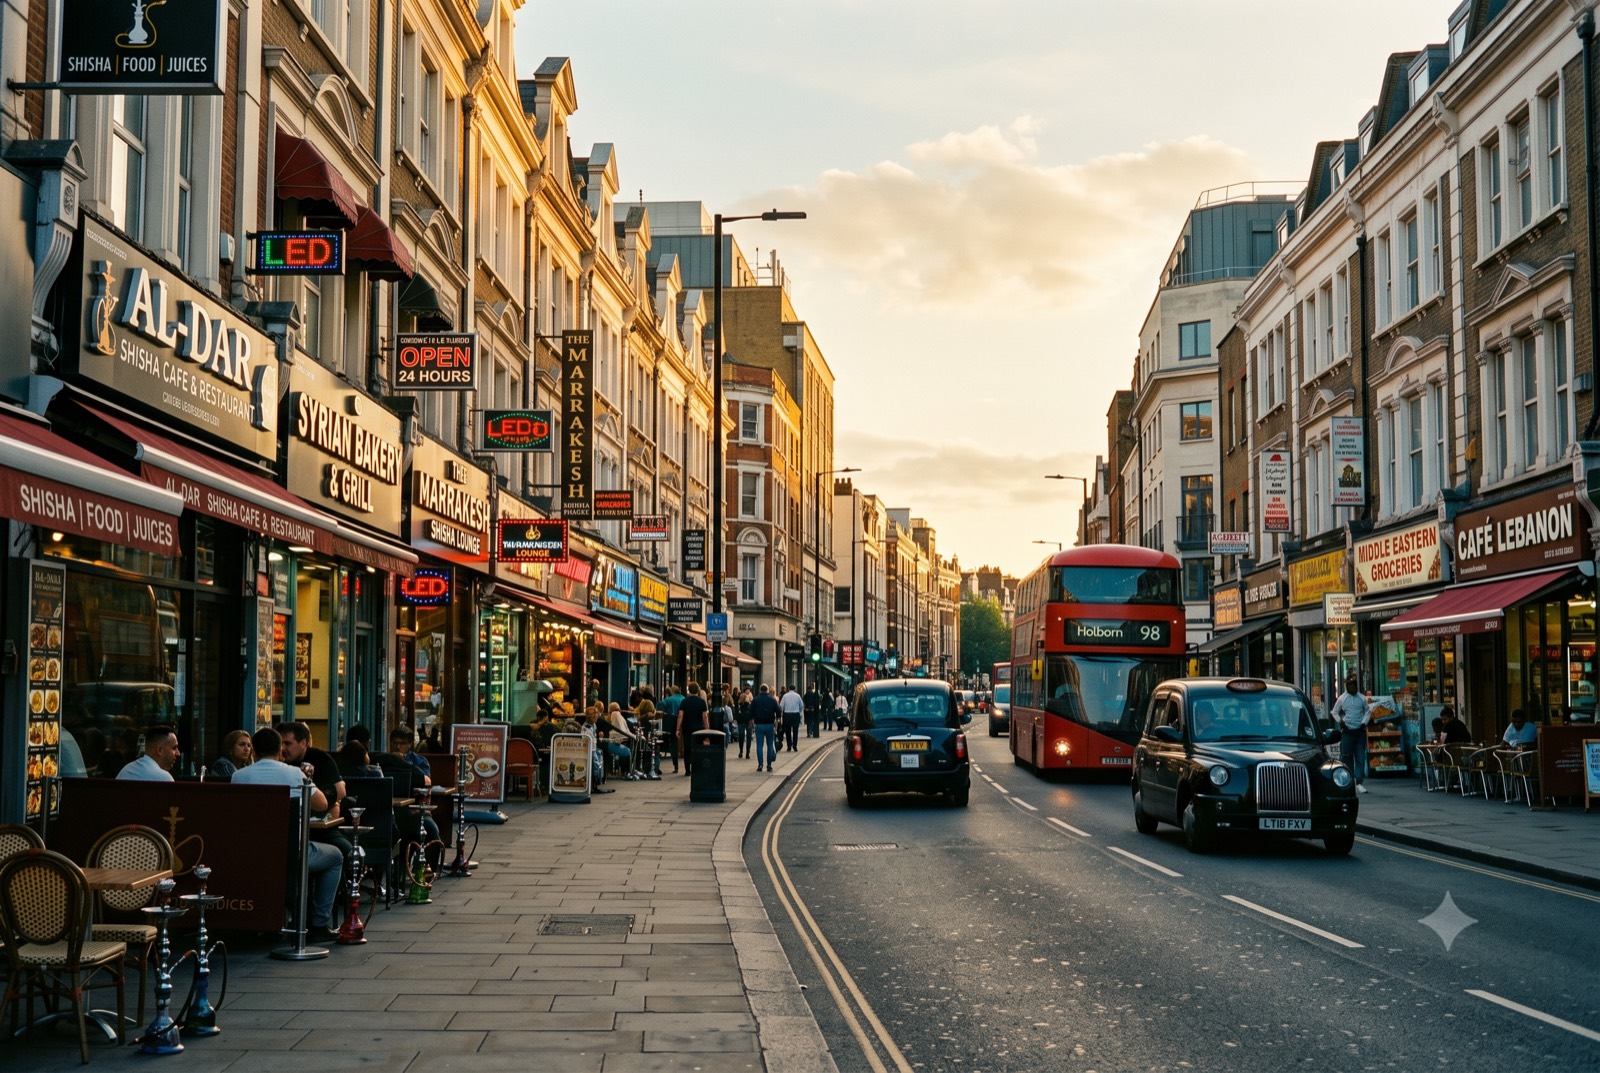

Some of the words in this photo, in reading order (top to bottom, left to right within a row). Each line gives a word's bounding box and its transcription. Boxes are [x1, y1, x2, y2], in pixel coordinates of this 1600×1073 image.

[68, 57, 111, 72] SHISHA
[123, 57, 156, 72] FOOD
[167, 57, 207, 72] JUICES
[265, 238, 331, 265] LED
[128, 267, 253, 391] AL-DAR
[566, 335, 590, 344] THE
[399, 370, 415, 382] 24
[420, 370, 471, 382] HOURS
[400, 347, 471, 367] OPEN
[120, 339, 160, 378] SHISHA
[163, 360, 188, 392] CAFE
[190, 376, 198, 394] &
[200, 379, 255, 423] RESTAURANT
[299, 392, 352, 461] SYRIAN
[355, 425, 403, 486] BAKERY
[568, 348, 587, 498] MARRAKESH
[330, 464, 338, 498] &
[342, 469, 374, 513] GRILL
[420, 471, 490, 533] MARRAKESH
[20, 484, 76, 523] SHISHA
[86, 502, 123, 534] FOOD
[133, 515, 172, 547] JUICES
[207, 493, 238, 523] SHISHA
[240, 506, 260, 529] CAFE
[262, 514, 268, 530] &
[270, 516, 315, 546] RESTAURANT
[1458, 516, 1494, 560] CAFÉ
[1497, 503, 1573, 553] LEBANON
[431, 520, 456, 547] SHISHA
[456, 529, 480, 556] LOUNGE
[1358, 539, 1390, 564] MIDDLE
[1393, 526, 1437, 555] EASTERN
[1371, 553, 1422, 582] GROCERIES
[1077, 626, 1123, 638] Holborn
[1140, 625, 1161, 641] 98
[1264, 819, 1286, 829] LT18
